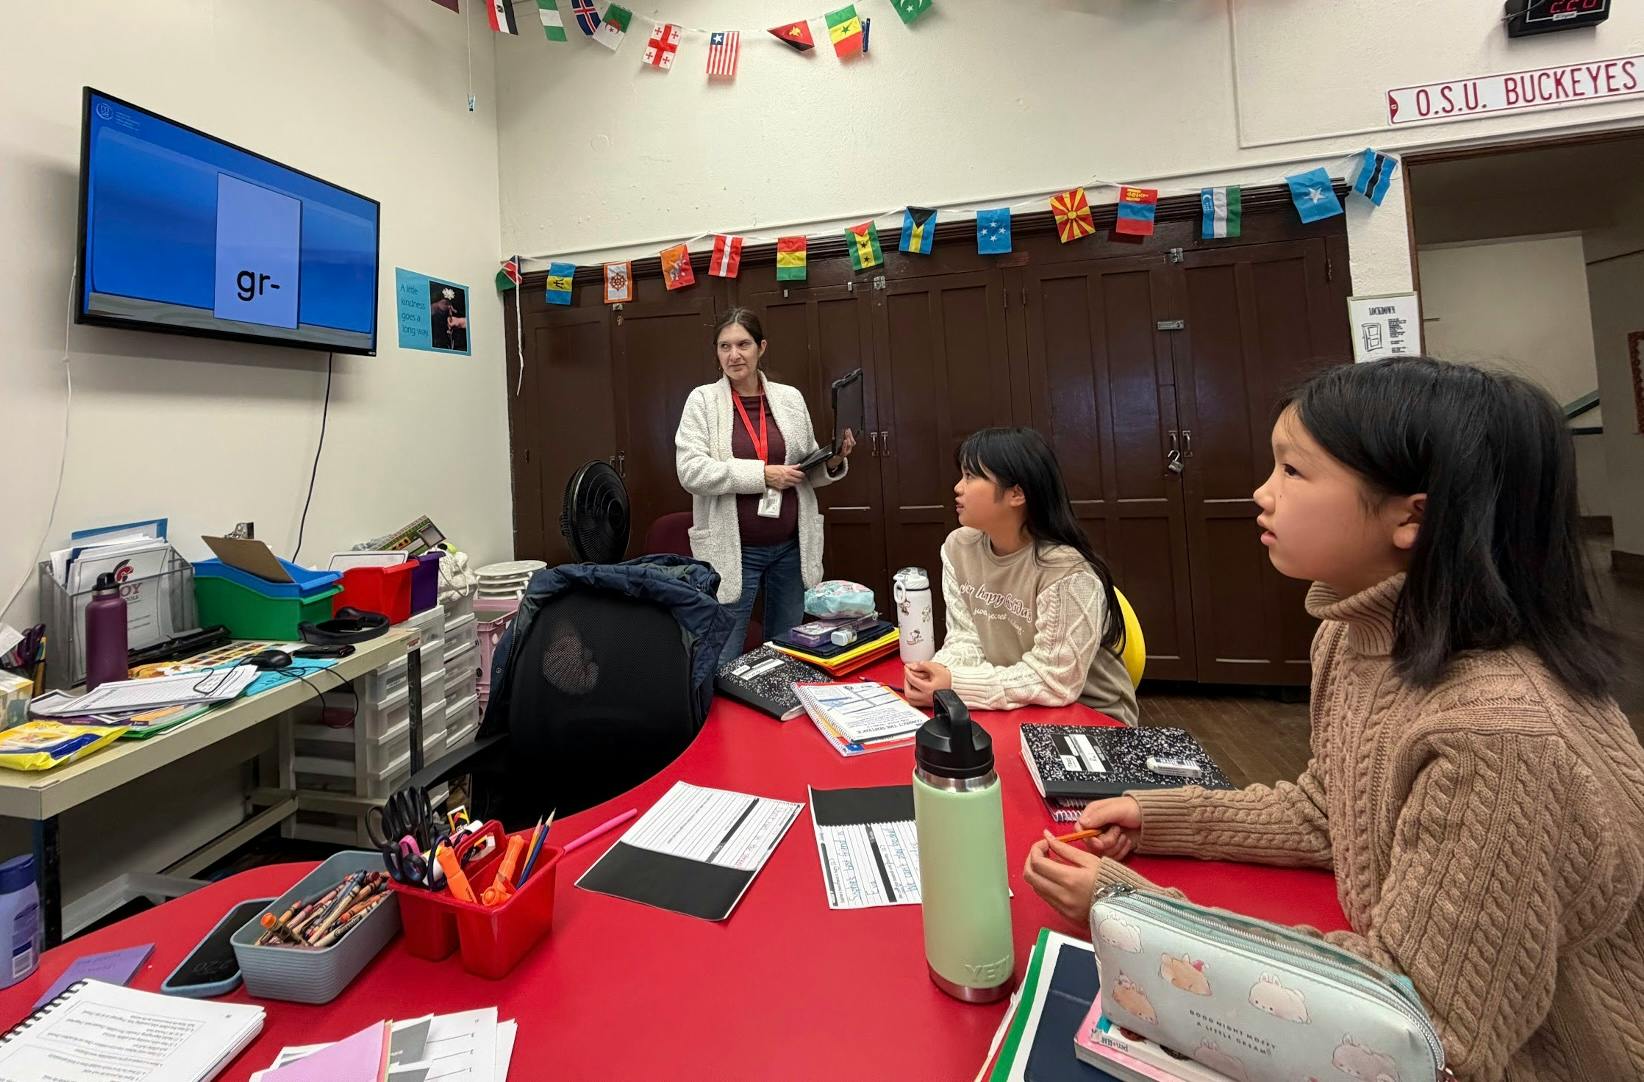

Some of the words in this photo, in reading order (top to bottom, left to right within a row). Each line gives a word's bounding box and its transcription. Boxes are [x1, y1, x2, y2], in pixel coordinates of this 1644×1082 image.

[1416, 82, 1487, 117] O.S.U.
[1504, 60, 1637, 106] BUCKEYES
[237, 270, 281, 301] gr-
[400, 283, 406, 293] A
[407, 285, 418, 295] little
[401, 299, 426, 310] kindness
[402, 312, 416, 322] goes
[402, 325, 416, 336] long
[1216, 1021, 1244, 1036] NIGHT
